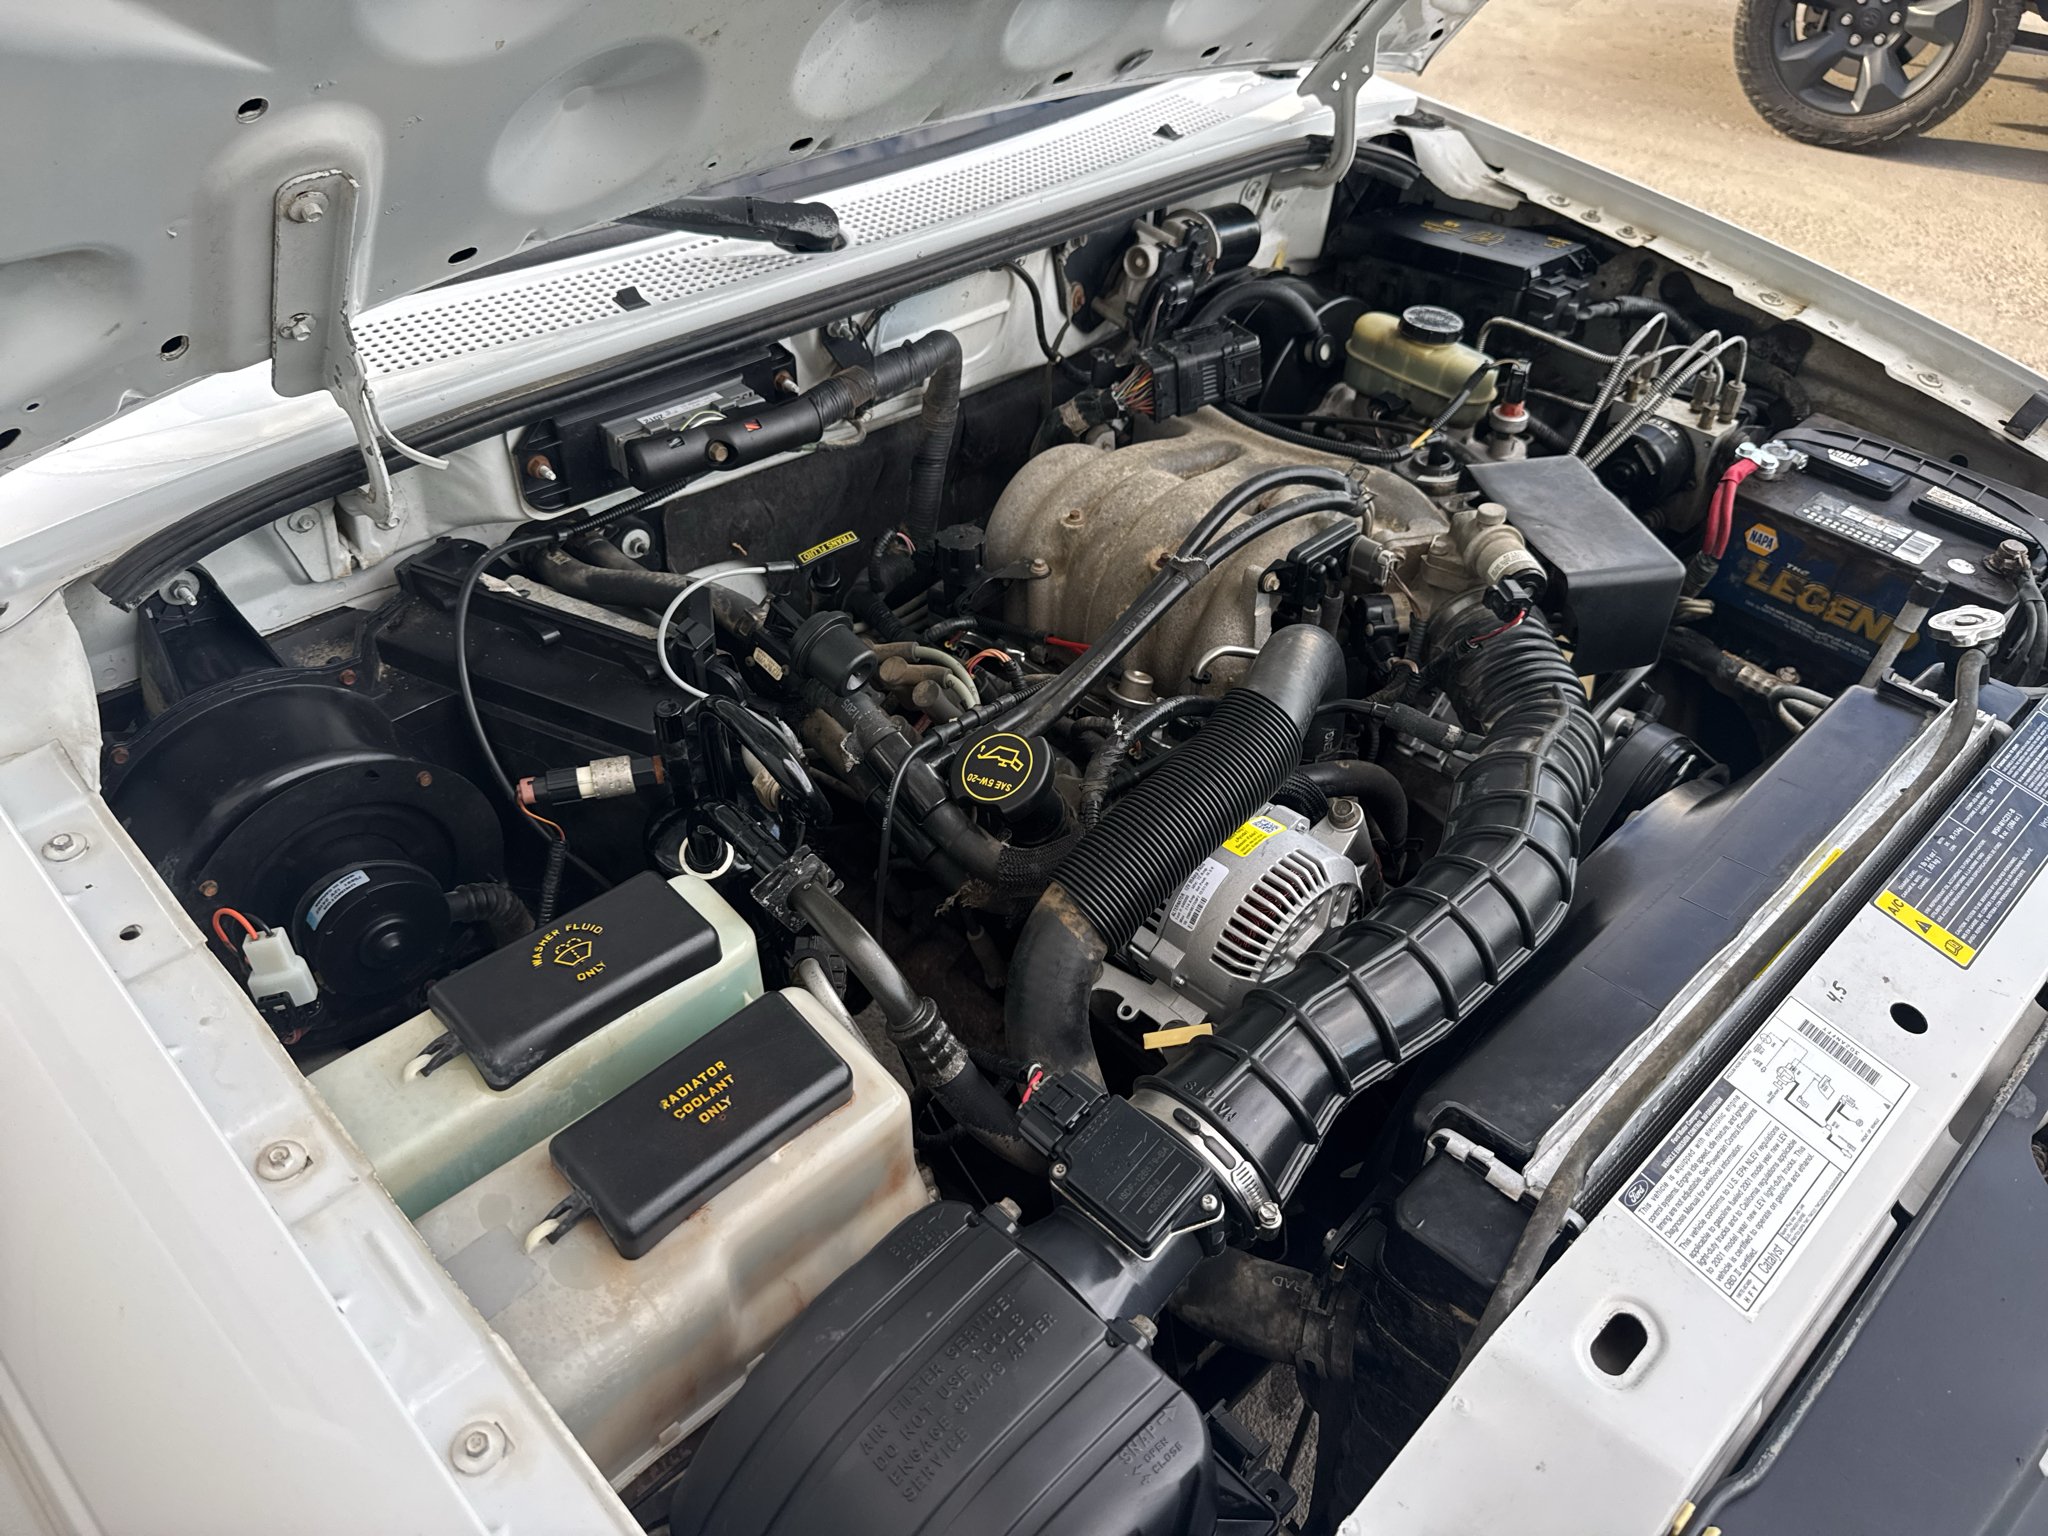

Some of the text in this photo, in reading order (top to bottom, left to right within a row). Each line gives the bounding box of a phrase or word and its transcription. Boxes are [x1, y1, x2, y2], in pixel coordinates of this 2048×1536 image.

[802, 533, 853, 560] TRANS FLUID
[1750, 530, 1774, 549] NAPA
[966, 773, 1013, 792] SAE 5W-20
[1885, 897, 1905, 916] A/C
[532, 922, 604, 969] WASHER FLUID
[576, 961, 607, 983] ONLY
[1826, 980, 1847, 1004] 4.5
[660, 1059, 727, 1110] RADIATOR
[673, 1073, 735, 1120] COOLANT
[698, 1095, 732, 1125] ONLY
[1636, 1093, 1742, 1216] This vehicle is equipped with electronic engine
[1660, 1149, 1678, 1169] VEHICLE
[1686, 1117, 1705, 1137] CONTROL
[1669, 1132, 1681, 1144] Ford
[1646, 1099, 1751, 1224] control systems. Engine idle speed, idle mixture, and ignition
[1788, 1169, 1801, 1183] and
[1794, 1150, 1815, 1173] ethanol.
[1625, 1181, 1646, 1204] Ford
[1654, 1212, 1673, 1233] timing
[1667, 1205, 1678, 1217] are
[1673, 1197, 1684, 1209] not
[1679, 1173, 1704, 1202] adjustable.
[1697, 1164, 1710, 1178] See
[1704, 1141, 1729, 1169] Powertrain
[1663, 1141, 1744, 1240] Diagnosis Manual for additional information.
[1677, 1235, 1692, 1251] This
[1687, 1216, 1707, 1239] vehicle
[1702, 1192, 1726, 1220] conforms
[1721, 1186, 1731, 1196] to
[1734, 1163, 1749, 1178] EPA
[1743, 1148, 1760, 1167] NLEV
[1755, 1123, 1782, 1153] regulations
[1686, 1129, 1789, 1260] applicable to gasoline fueled 2001 model year new LEV
[1695, 1136, 1799, 1268] light-duty trucks and to California regulations applicable
[1772, 1179, 1795, 1205] gasoline
[1704, 1143, 1806, 1275] to 2001 model year new LEV light-duty trucks. This
[1753, 1207, 1774, 1232] operate
[1768, 1200, 1778, 1211] on
[1732, 1232, 1754, 1258] certified
[1748, 1226, 1758, 1237] to
[1713, 1259, 1733, 1283] vehicle
[1722, 1272, 1738, 1291] OBD
[1736, 1245, 1759, 1271] certified.
[1728, 1253, 1738, 1264] is
[1755, 1240, 1787, 1277] Catalyst
[872, 1312, 1025, 1472] DO NOT USE TOOLS
[887, 1311, 1058, 1488] ENGAGE SNAPS AFTER
[859, 1423, 889, 1456] AIR
[888, 1362, 945, 1420] FILTER
[1118, 1425, 1157, 1465] SNAP
[1143, 1436, 1169, 1463] OPEN
[1152, 1441, 1183, 1474] CLOSE
[902, 1427, 970, 1502] SERVICE
